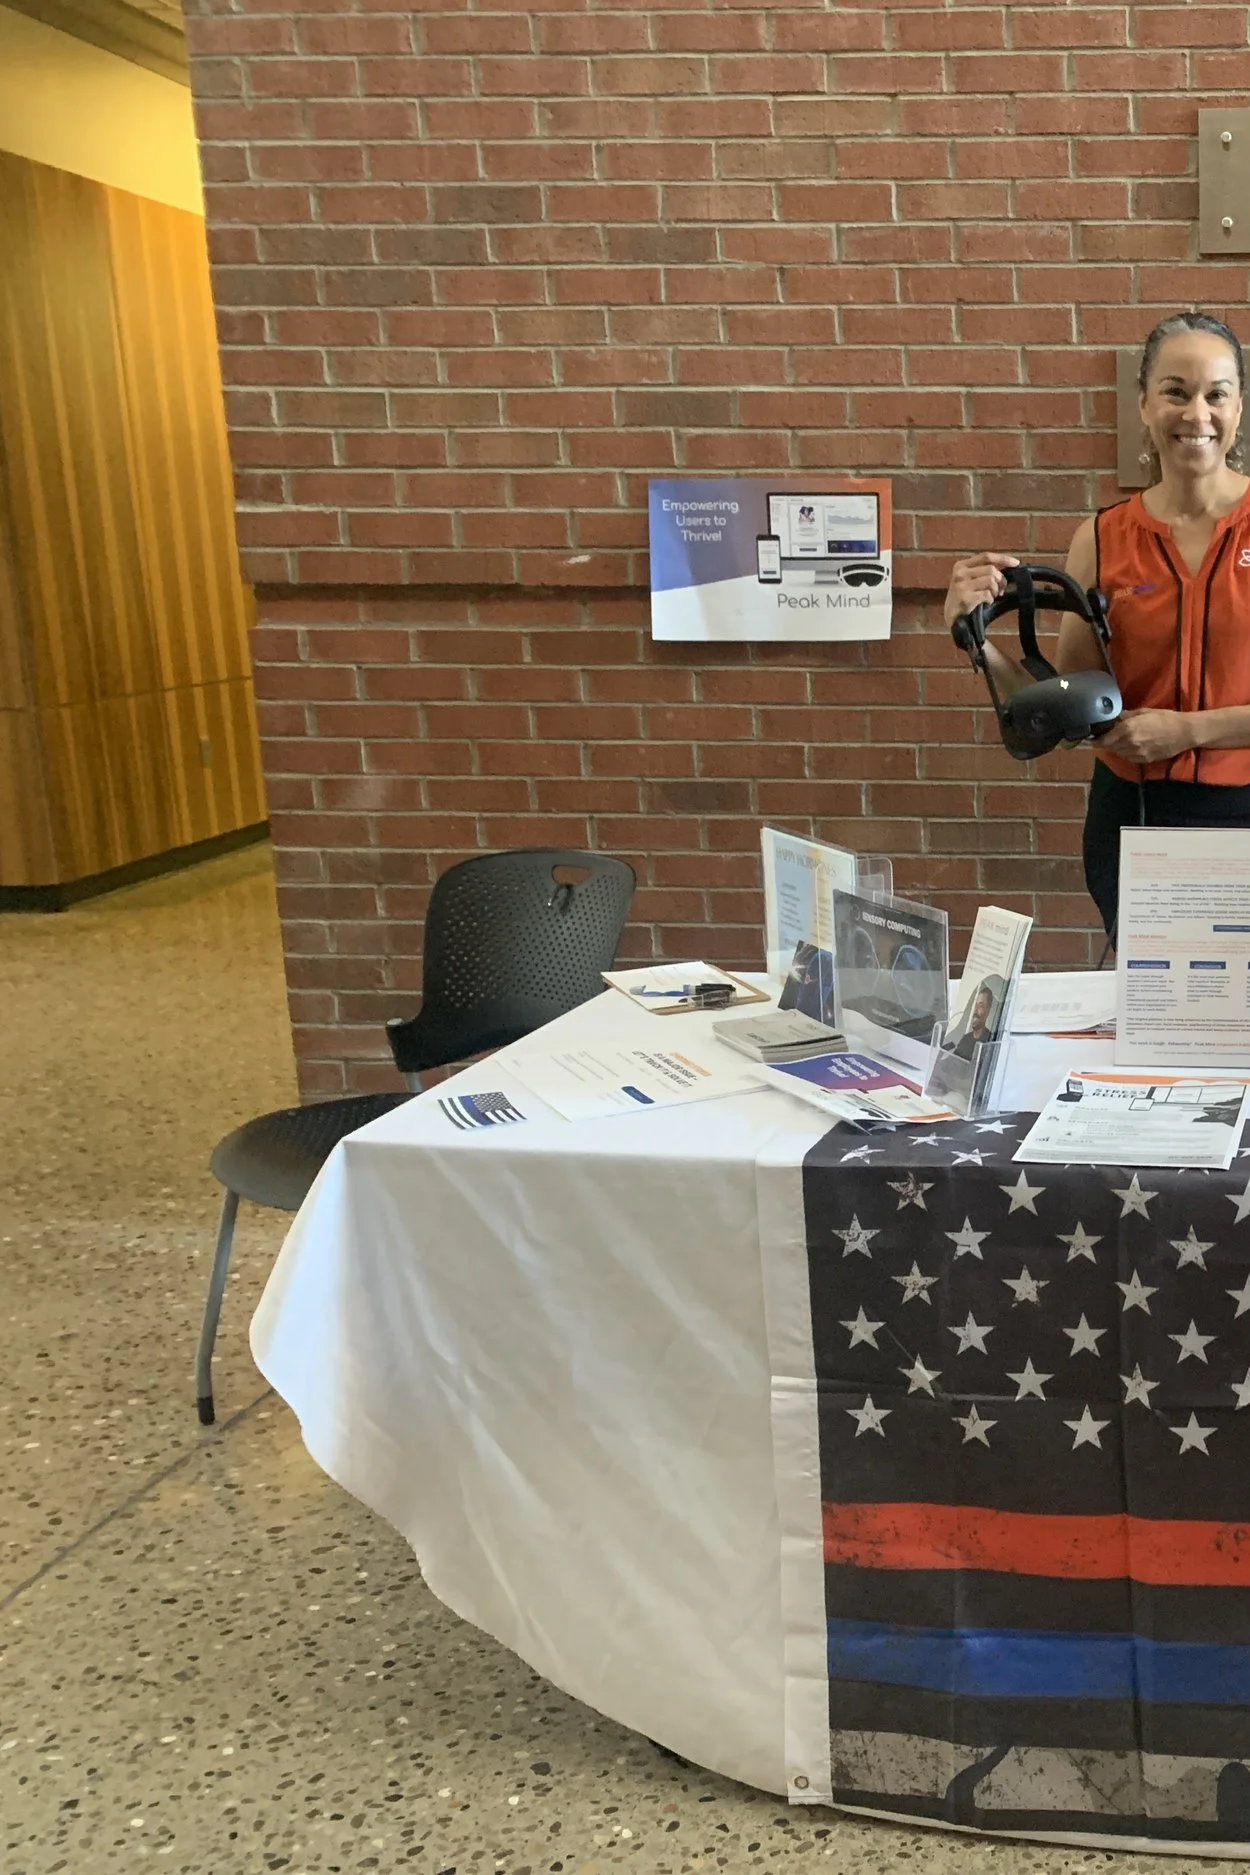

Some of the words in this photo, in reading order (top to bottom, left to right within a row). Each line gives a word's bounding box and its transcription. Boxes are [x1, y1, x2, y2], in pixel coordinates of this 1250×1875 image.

[662, 499, 739, 513] Empowering
[676, 515, 711, 526] Users
[714, 515, 727, 526] to
[778, 593, 820, 608] Peak
[827, 593, 870, 608] Mind
[886, 919, 921, 939] COMPUTING
